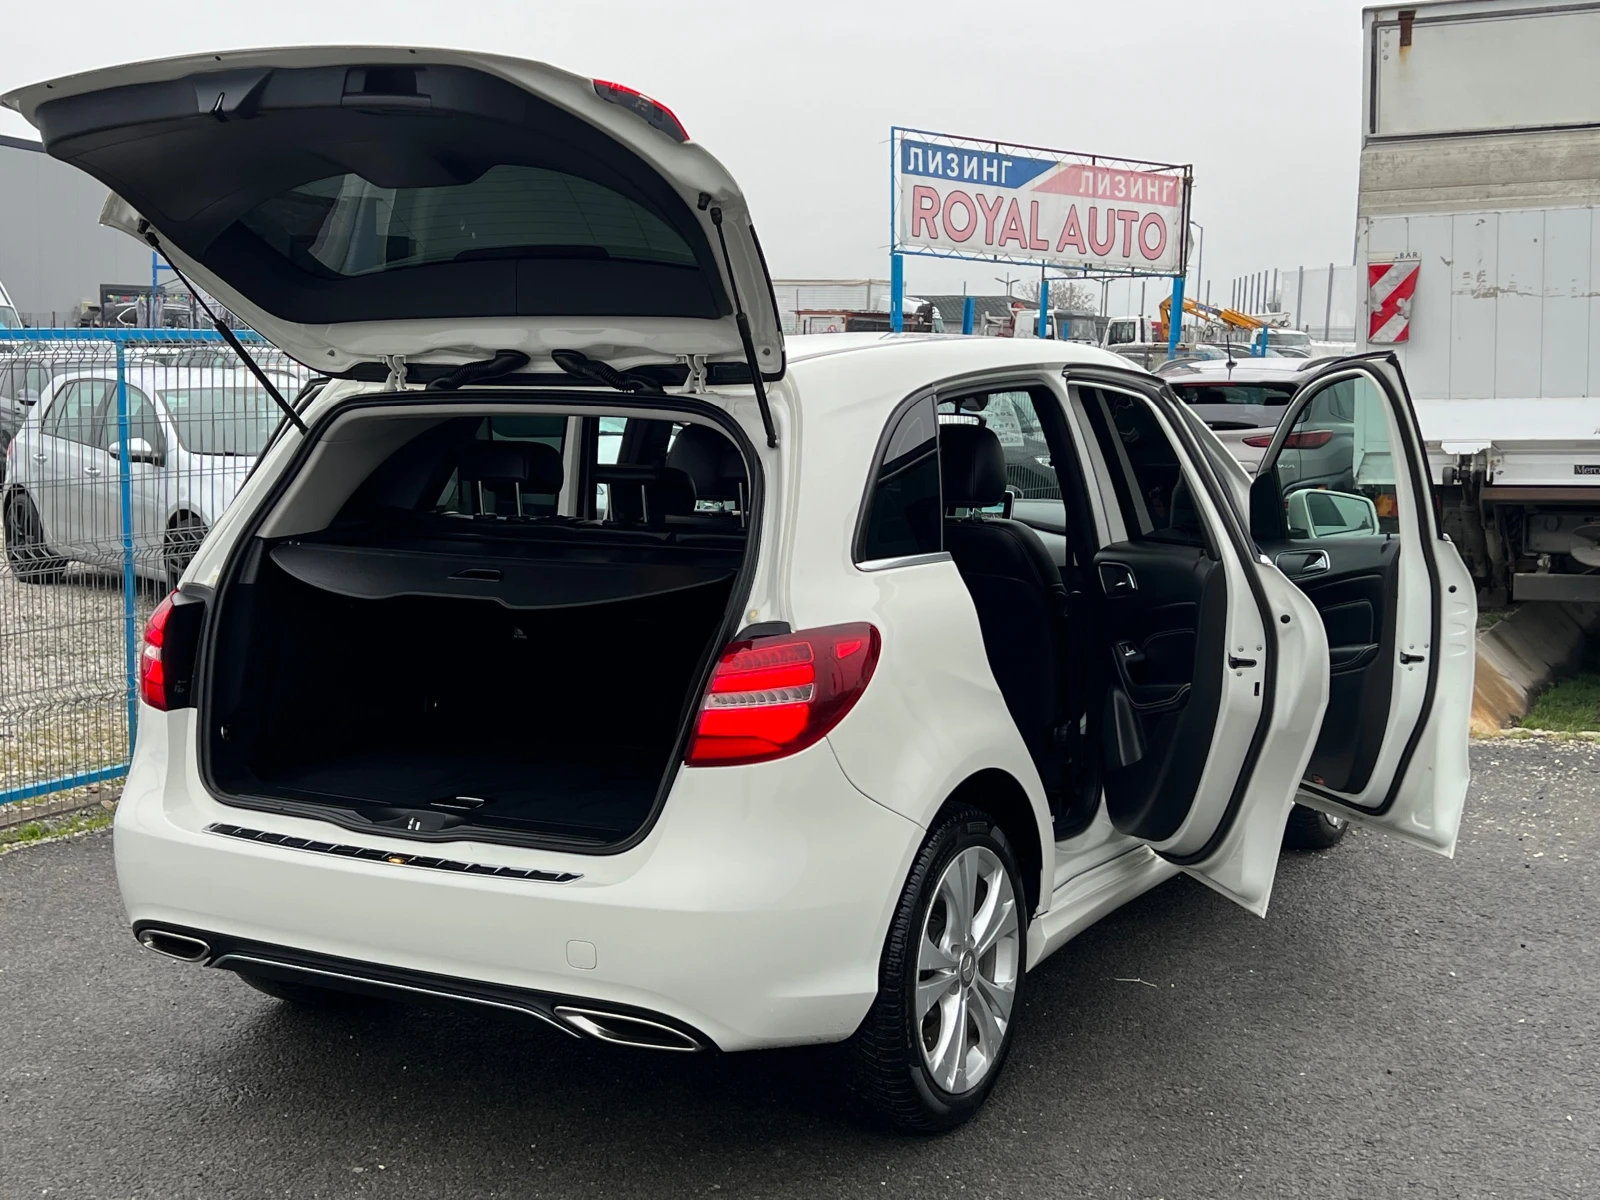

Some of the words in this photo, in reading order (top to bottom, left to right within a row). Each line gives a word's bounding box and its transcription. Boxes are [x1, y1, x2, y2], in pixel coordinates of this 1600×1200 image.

[908, 147, 1013, 184] ЛИЗИНГ
[1078, 171, 1174, 203] ЛИЗИНГ
[911, 185, 1050, 251] ROYAL
[1055, 203, 1168, 261] AUTO
